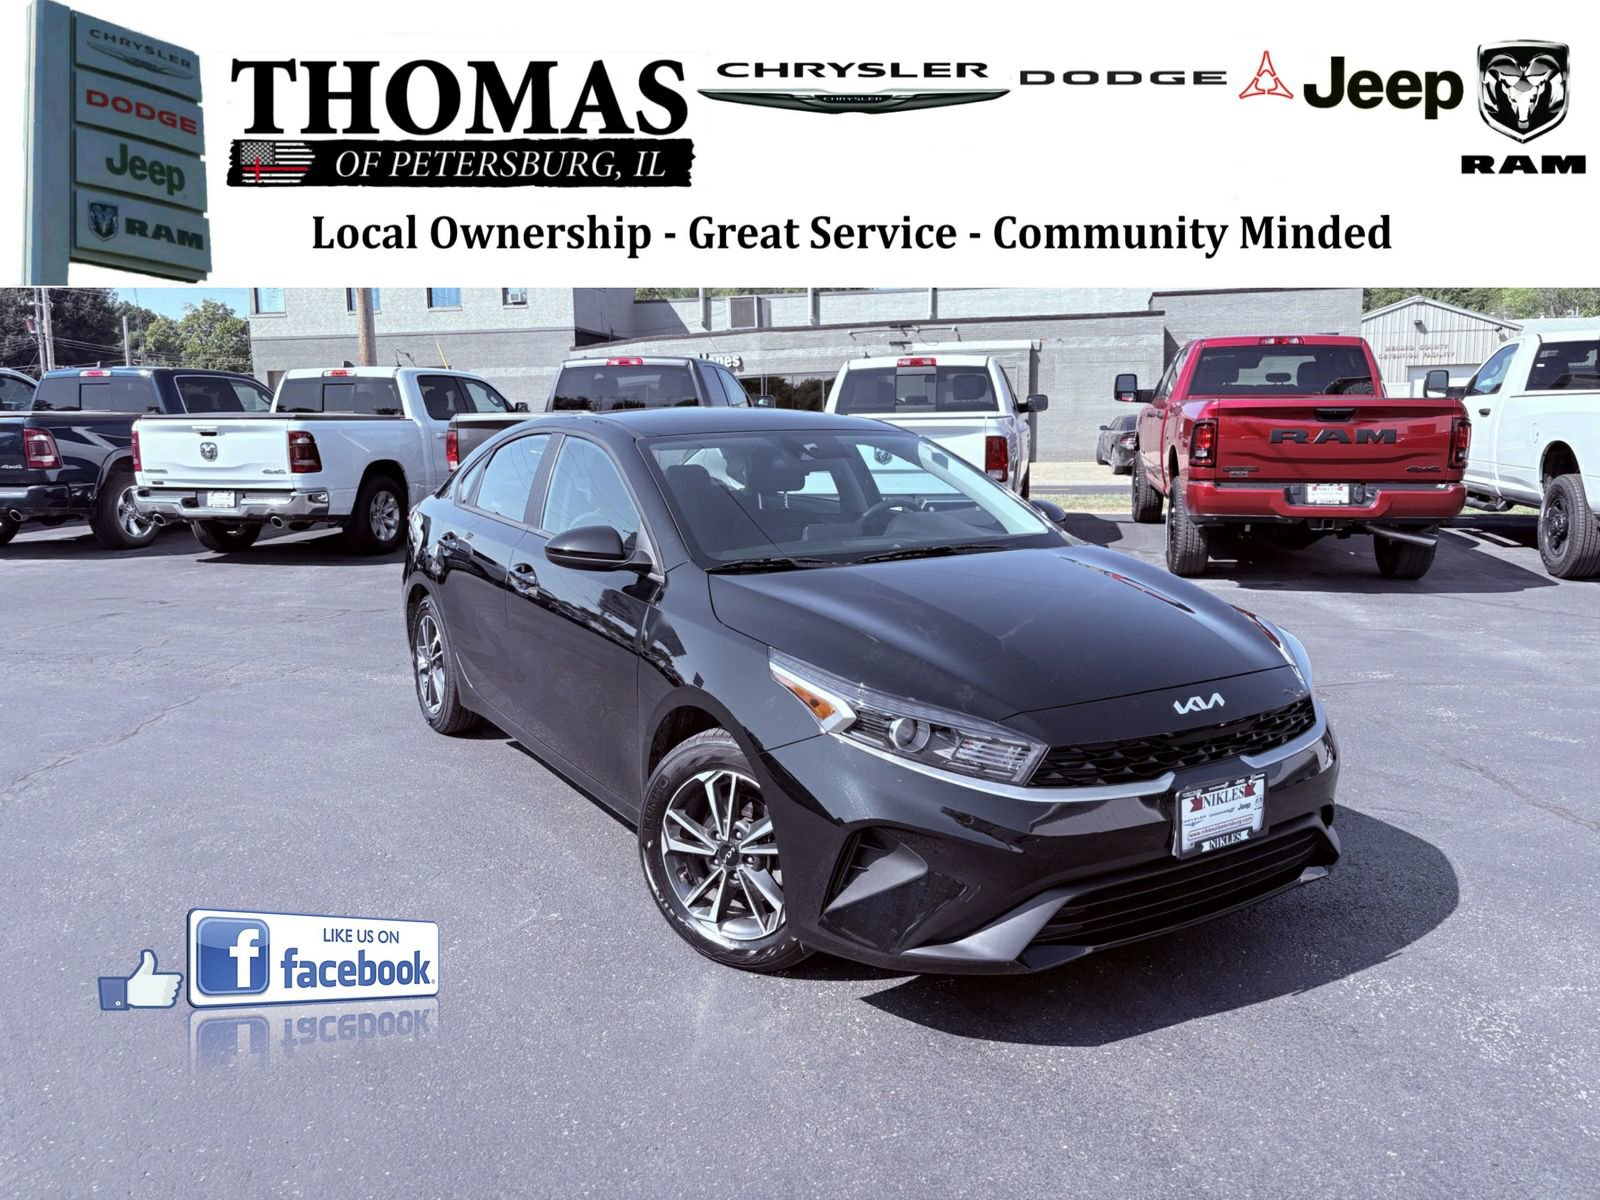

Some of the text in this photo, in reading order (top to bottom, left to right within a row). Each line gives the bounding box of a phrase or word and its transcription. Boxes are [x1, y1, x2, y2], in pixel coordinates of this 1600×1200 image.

[1270, 429, 1398, 444] RAM
[1173, 692, 1225, 715] KIA
[1203, 785, 1245, 808] NIKLES
[1209, 833, 1242, 850] NIKLES
